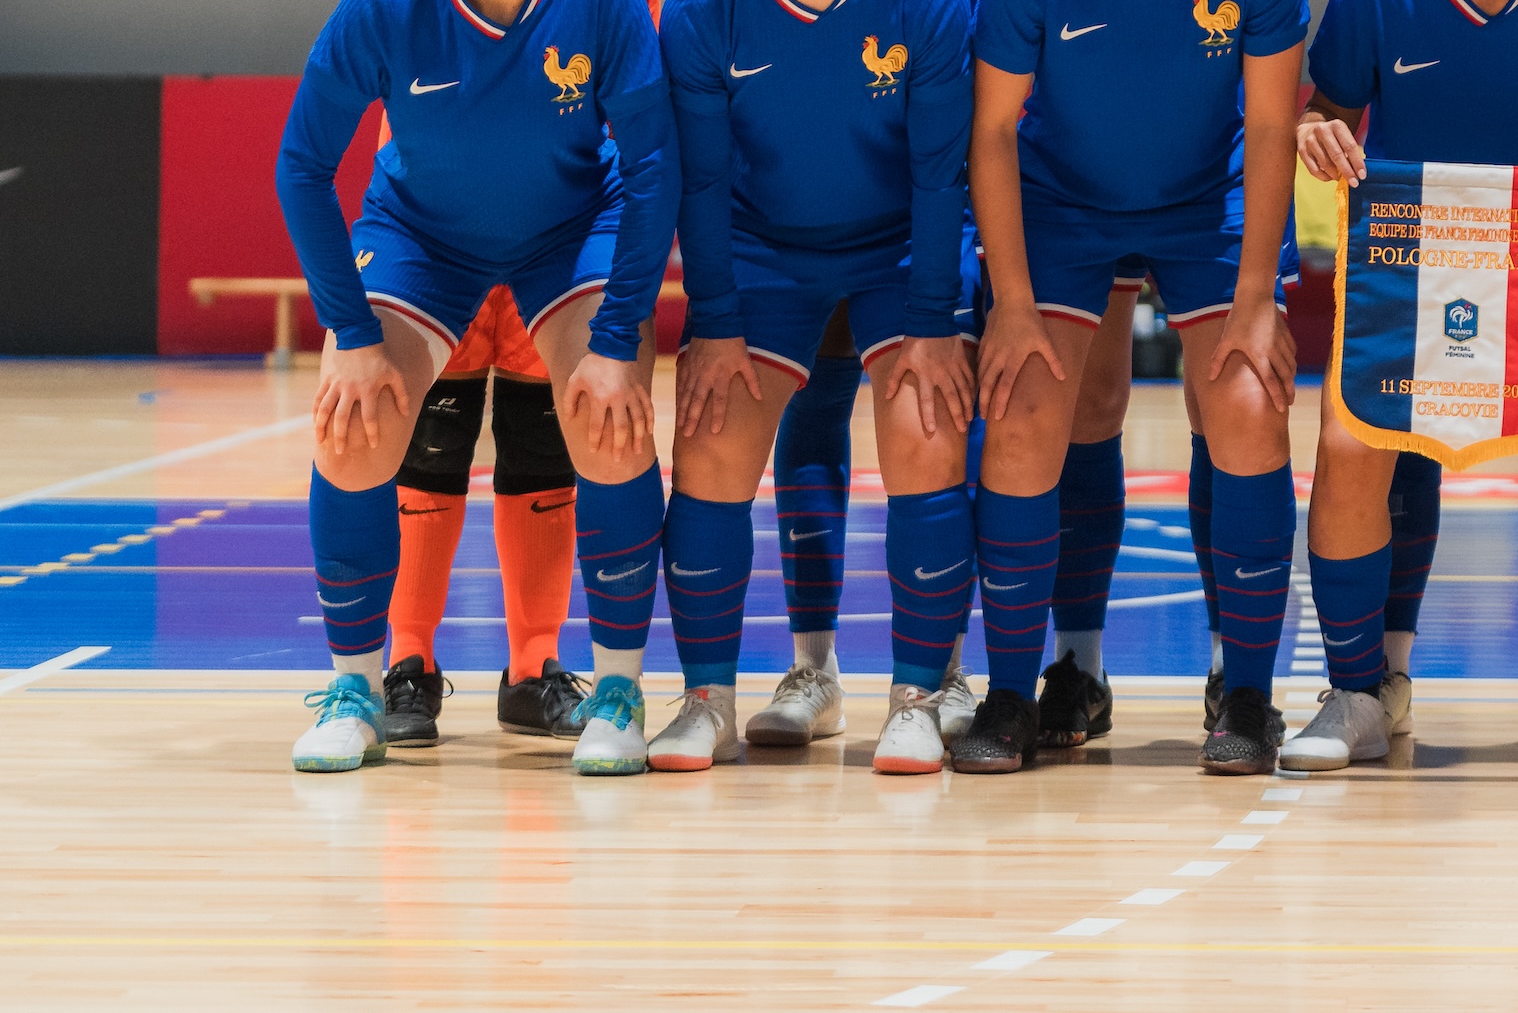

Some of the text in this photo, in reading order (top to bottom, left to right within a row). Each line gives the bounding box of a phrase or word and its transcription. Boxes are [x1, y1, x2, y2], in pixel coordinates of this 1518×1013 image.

[1370, 202, 1448, 221] RENCONTRE
[1369, 223, 1407, 238] EQUIPE
[1408, 224, 1423, 239] DE
[1425, 225, 1468, 241] FRANCE
[1445, 351, 1475, 359] FÉMININE
[1380, 379, 1396, 394] 11
[1399, 379, 1499, 399] SEPTEMBRE
[1416, 401, 1499, 418] CRACOVIE
